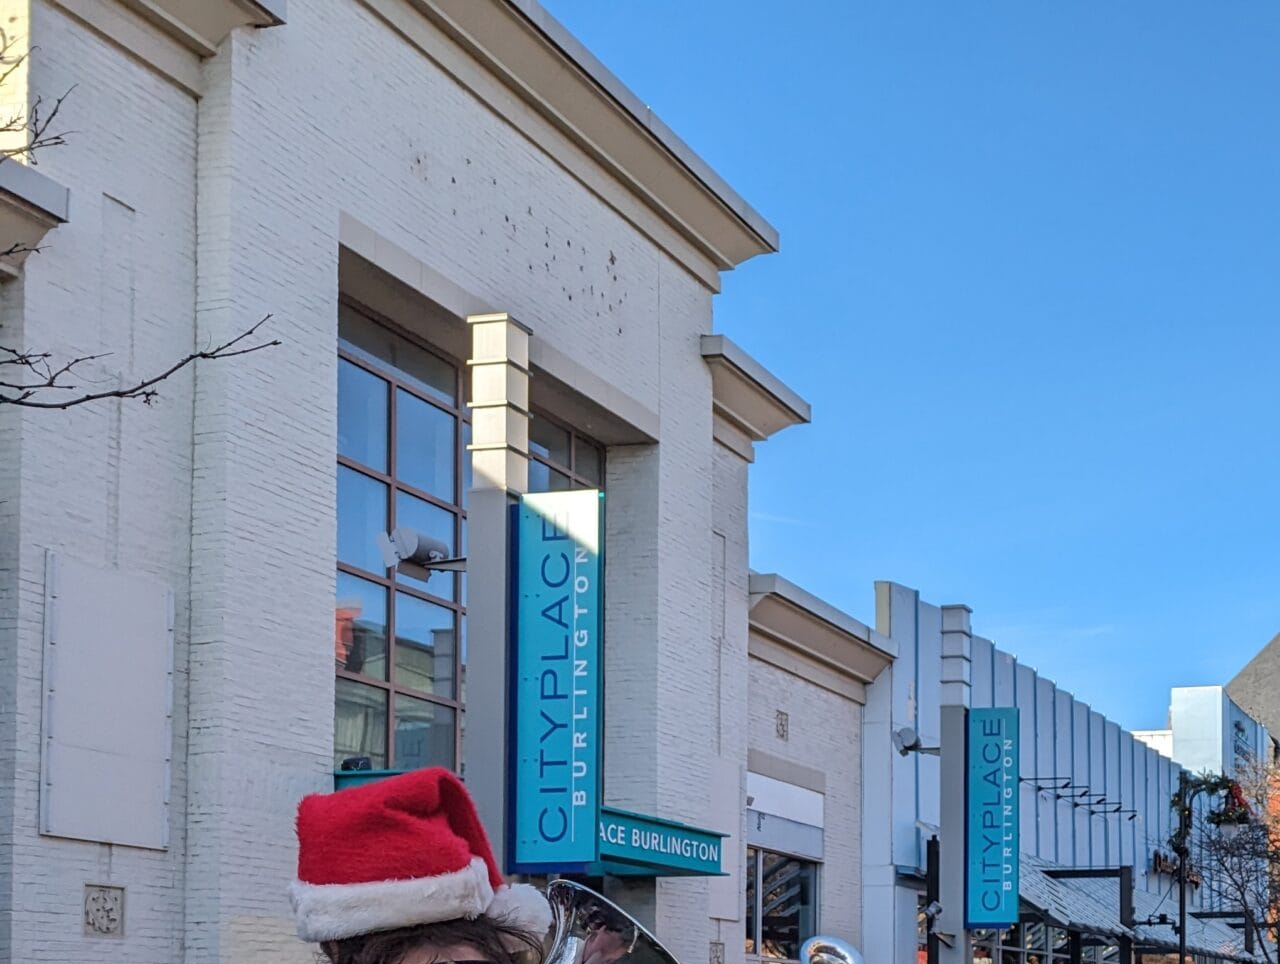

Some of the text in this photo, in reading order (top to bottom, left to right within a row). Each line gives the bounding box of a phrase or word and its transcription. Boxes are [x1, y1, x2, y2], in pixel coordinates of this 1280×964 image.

[538, 512, 571, 843] CITYPLACE
[573, 544, 590, 806] BURLINGTON
[631, 829, 719, 862] BURLINGTON
[981, 718, 1001, 912] CITYPLACE
[1003, 739, 1013, 891] BURLINGTON
